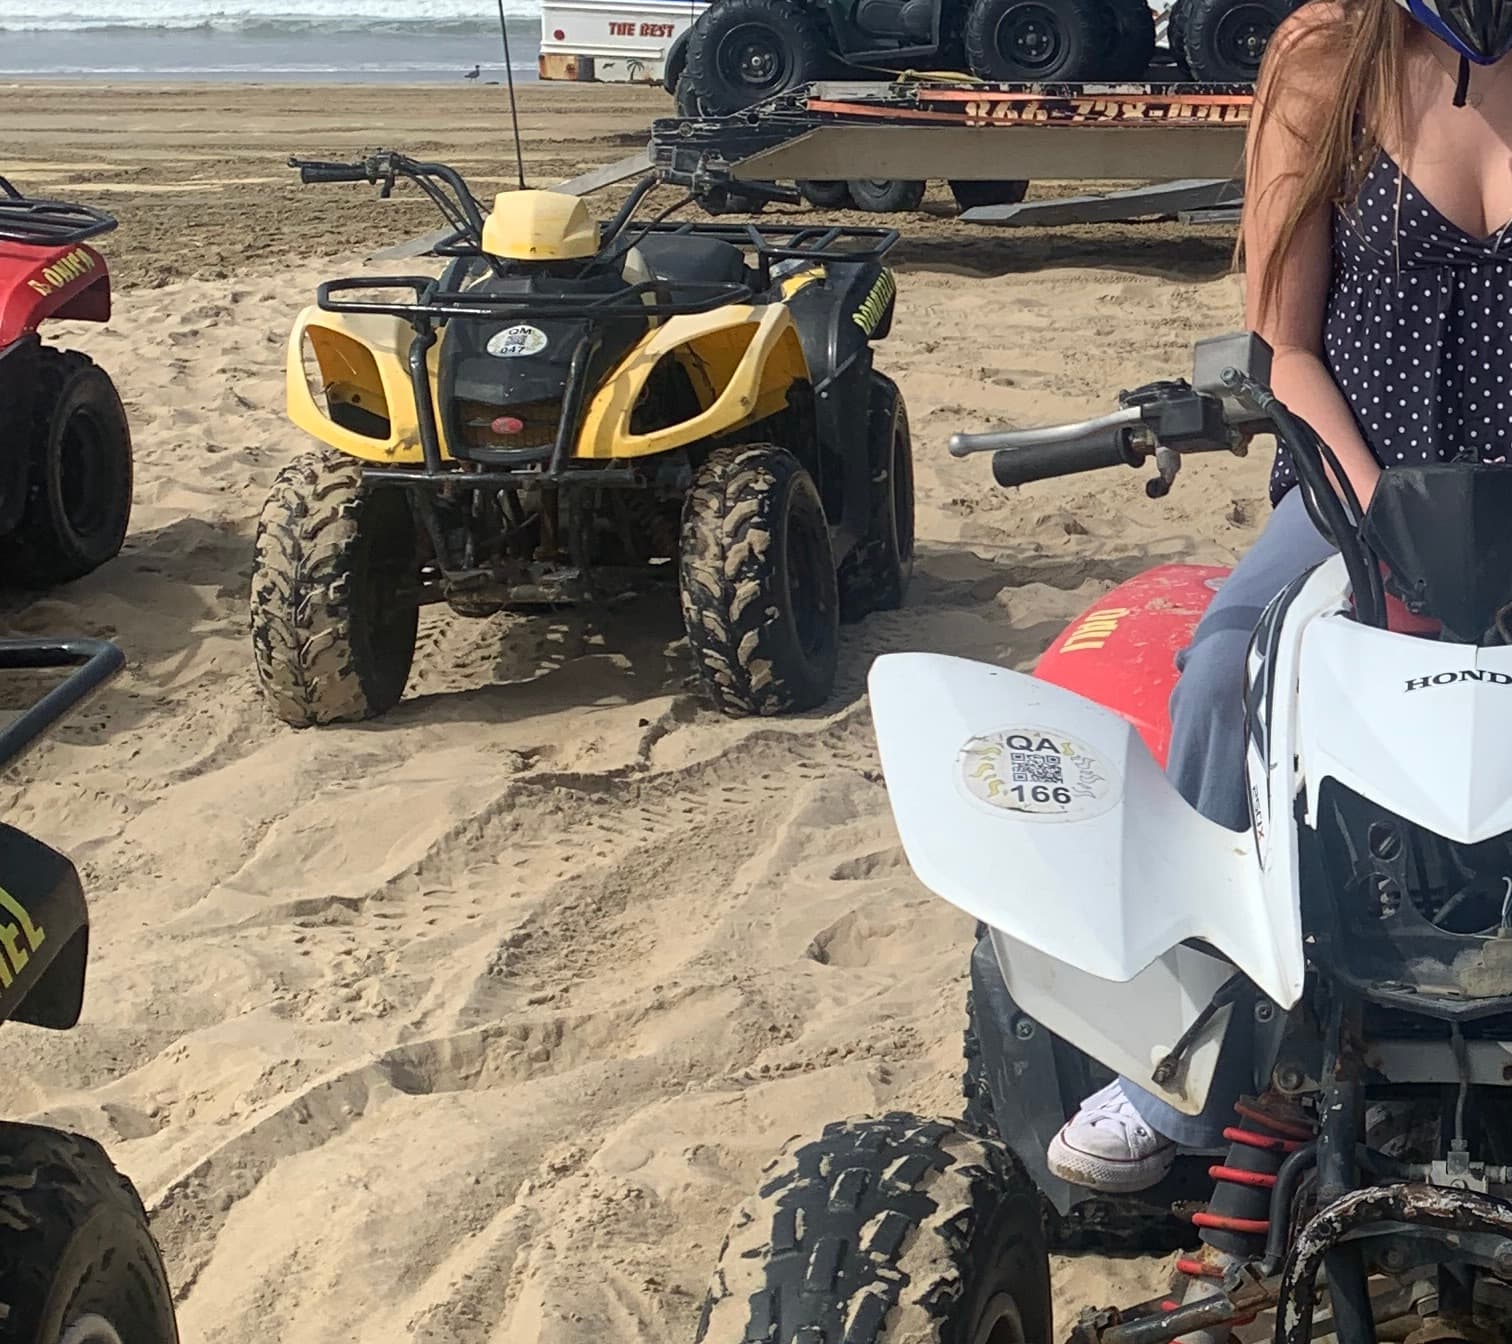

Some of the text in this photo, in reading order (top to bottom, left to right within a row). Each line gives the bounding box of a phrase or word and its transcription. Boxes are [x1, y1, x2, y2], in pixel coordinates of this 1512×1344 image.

[608, 21, 675, 38] THE BEST
[1005, 734, 1061, 754] QA
[1010, 784, 1073, 805] 166
